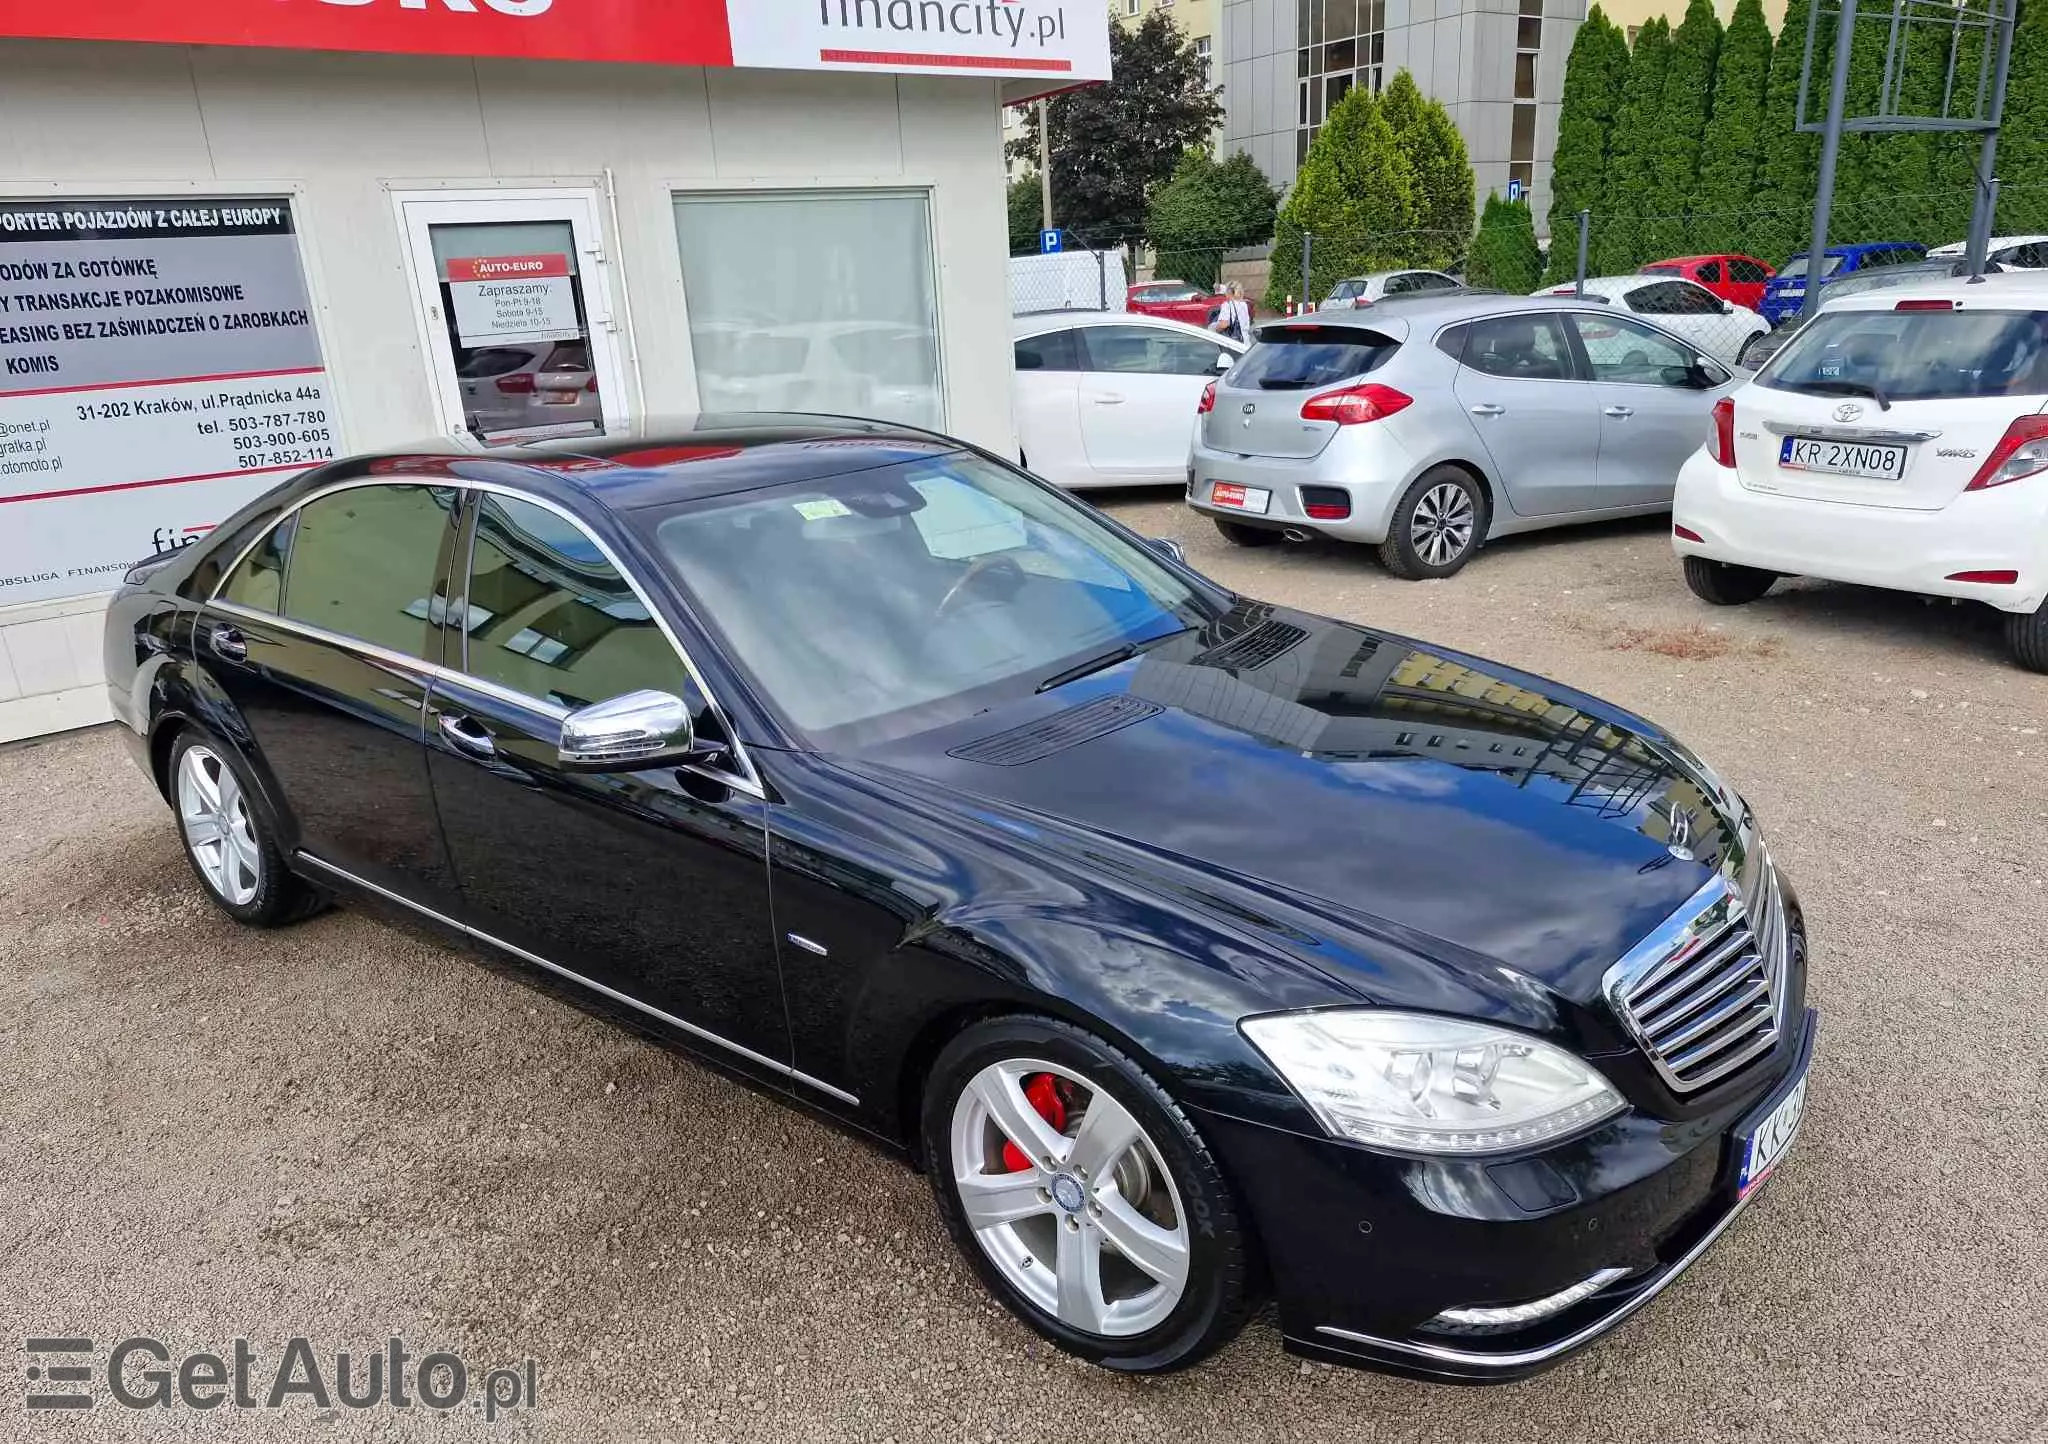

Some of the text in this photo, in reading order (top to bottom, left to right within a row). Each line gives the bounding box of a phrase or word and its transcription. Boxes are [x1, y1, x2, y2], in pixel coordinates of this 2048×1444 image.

[0, 206, 280, 231] ORTER POJAZDÓW Z CAŁEJ EUROPY
[1045, 232, 1057, 251] P
[52, 262, 76, 279] ZA
[78, 256, 159, 279] GOTÓWKĘ
[480, 261, 543, 273] AUTO-EURO
[14, 290, 122, 312] TRANSAKCJE
[124, 285, 244, 306] POZAKOMISOWE
[62, 322, 95, 340] BEZ
[97, 313, 206, 338] ZAŚWIADCZEŃ
[208, 315, 220, 330] O
[222, 310, 309, 330] ZAROBKACH
[5, 355, 59, 374] KOMIS
[76, 385, 321, 420] 31-202 Kraków, ul.Prądnicka 44a
[196, 410, 327, 435] tel. 503-787-780
[233, 428, 331, 450] 503-900-605
[238, 446, 334, 468] 507-852-114
[1794, 441, 1896, 471] KR 2XN08
